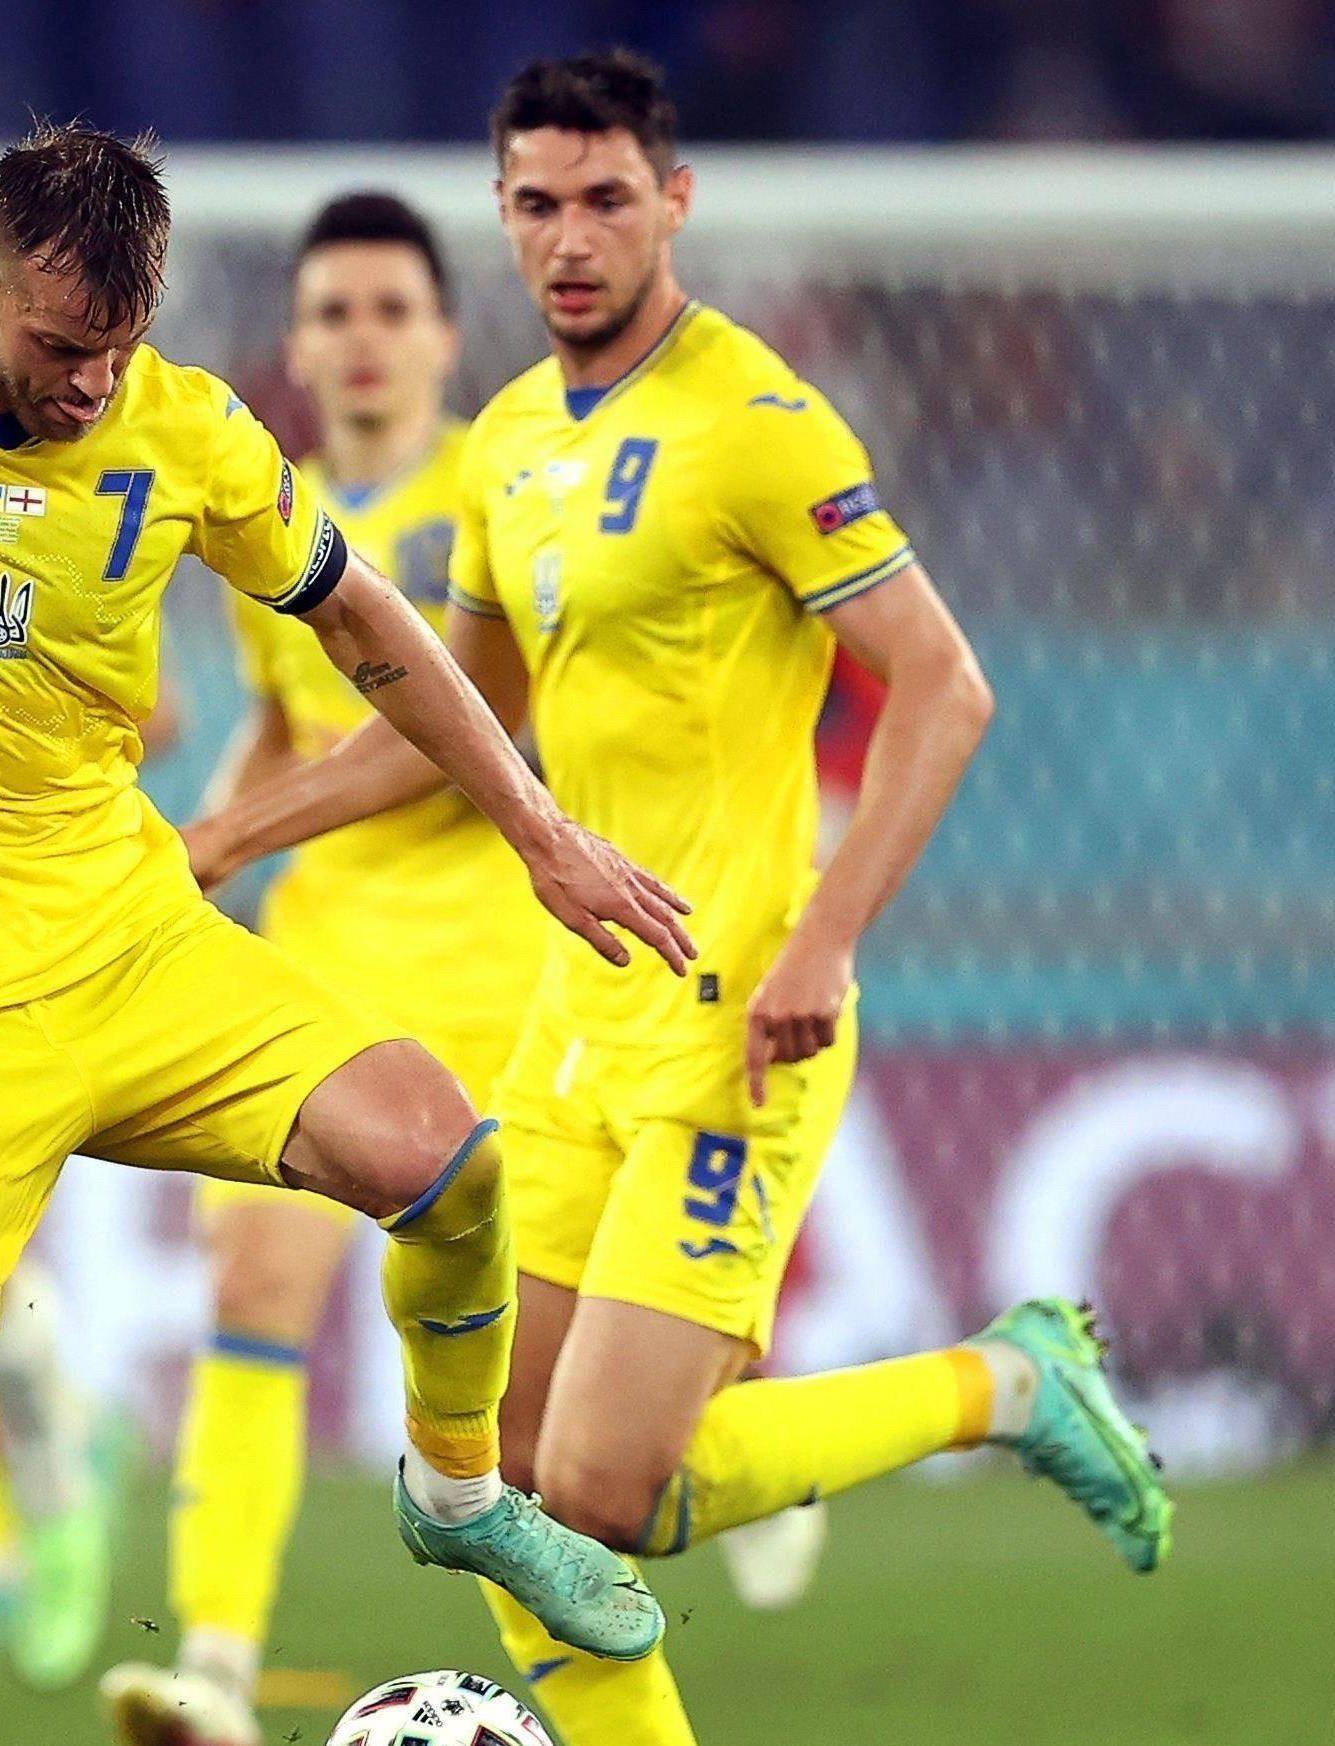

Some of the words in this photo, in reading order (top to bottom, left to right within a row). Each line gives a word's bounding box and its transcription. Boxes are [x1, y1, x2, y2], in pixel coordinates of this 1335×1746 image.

[95, 469, 155, 581] 7
[600, 437, 659, 534] 9
[683, 1131, 747, 1226] 9
